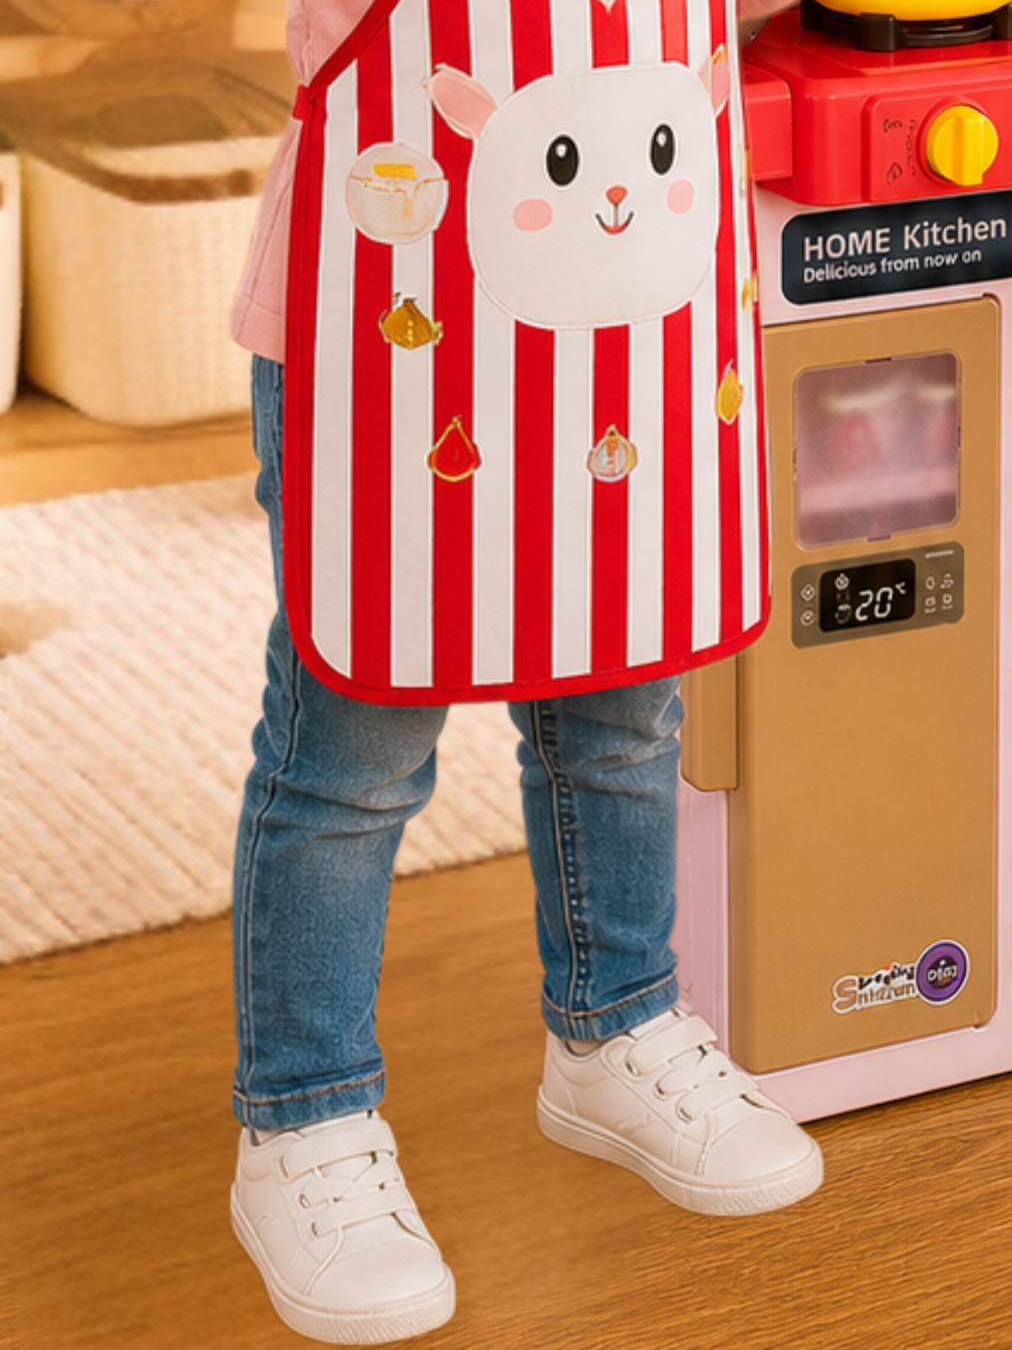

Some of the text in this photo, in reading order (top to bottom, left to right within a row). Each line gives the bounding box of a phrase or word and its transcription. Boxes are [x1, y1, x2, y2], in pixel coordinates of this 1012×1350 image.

[803, 226, 892, 263] HOME
[903, 216, 1008, 251] Kitchen
[803, 248, 982, 284] Delicious from now on
